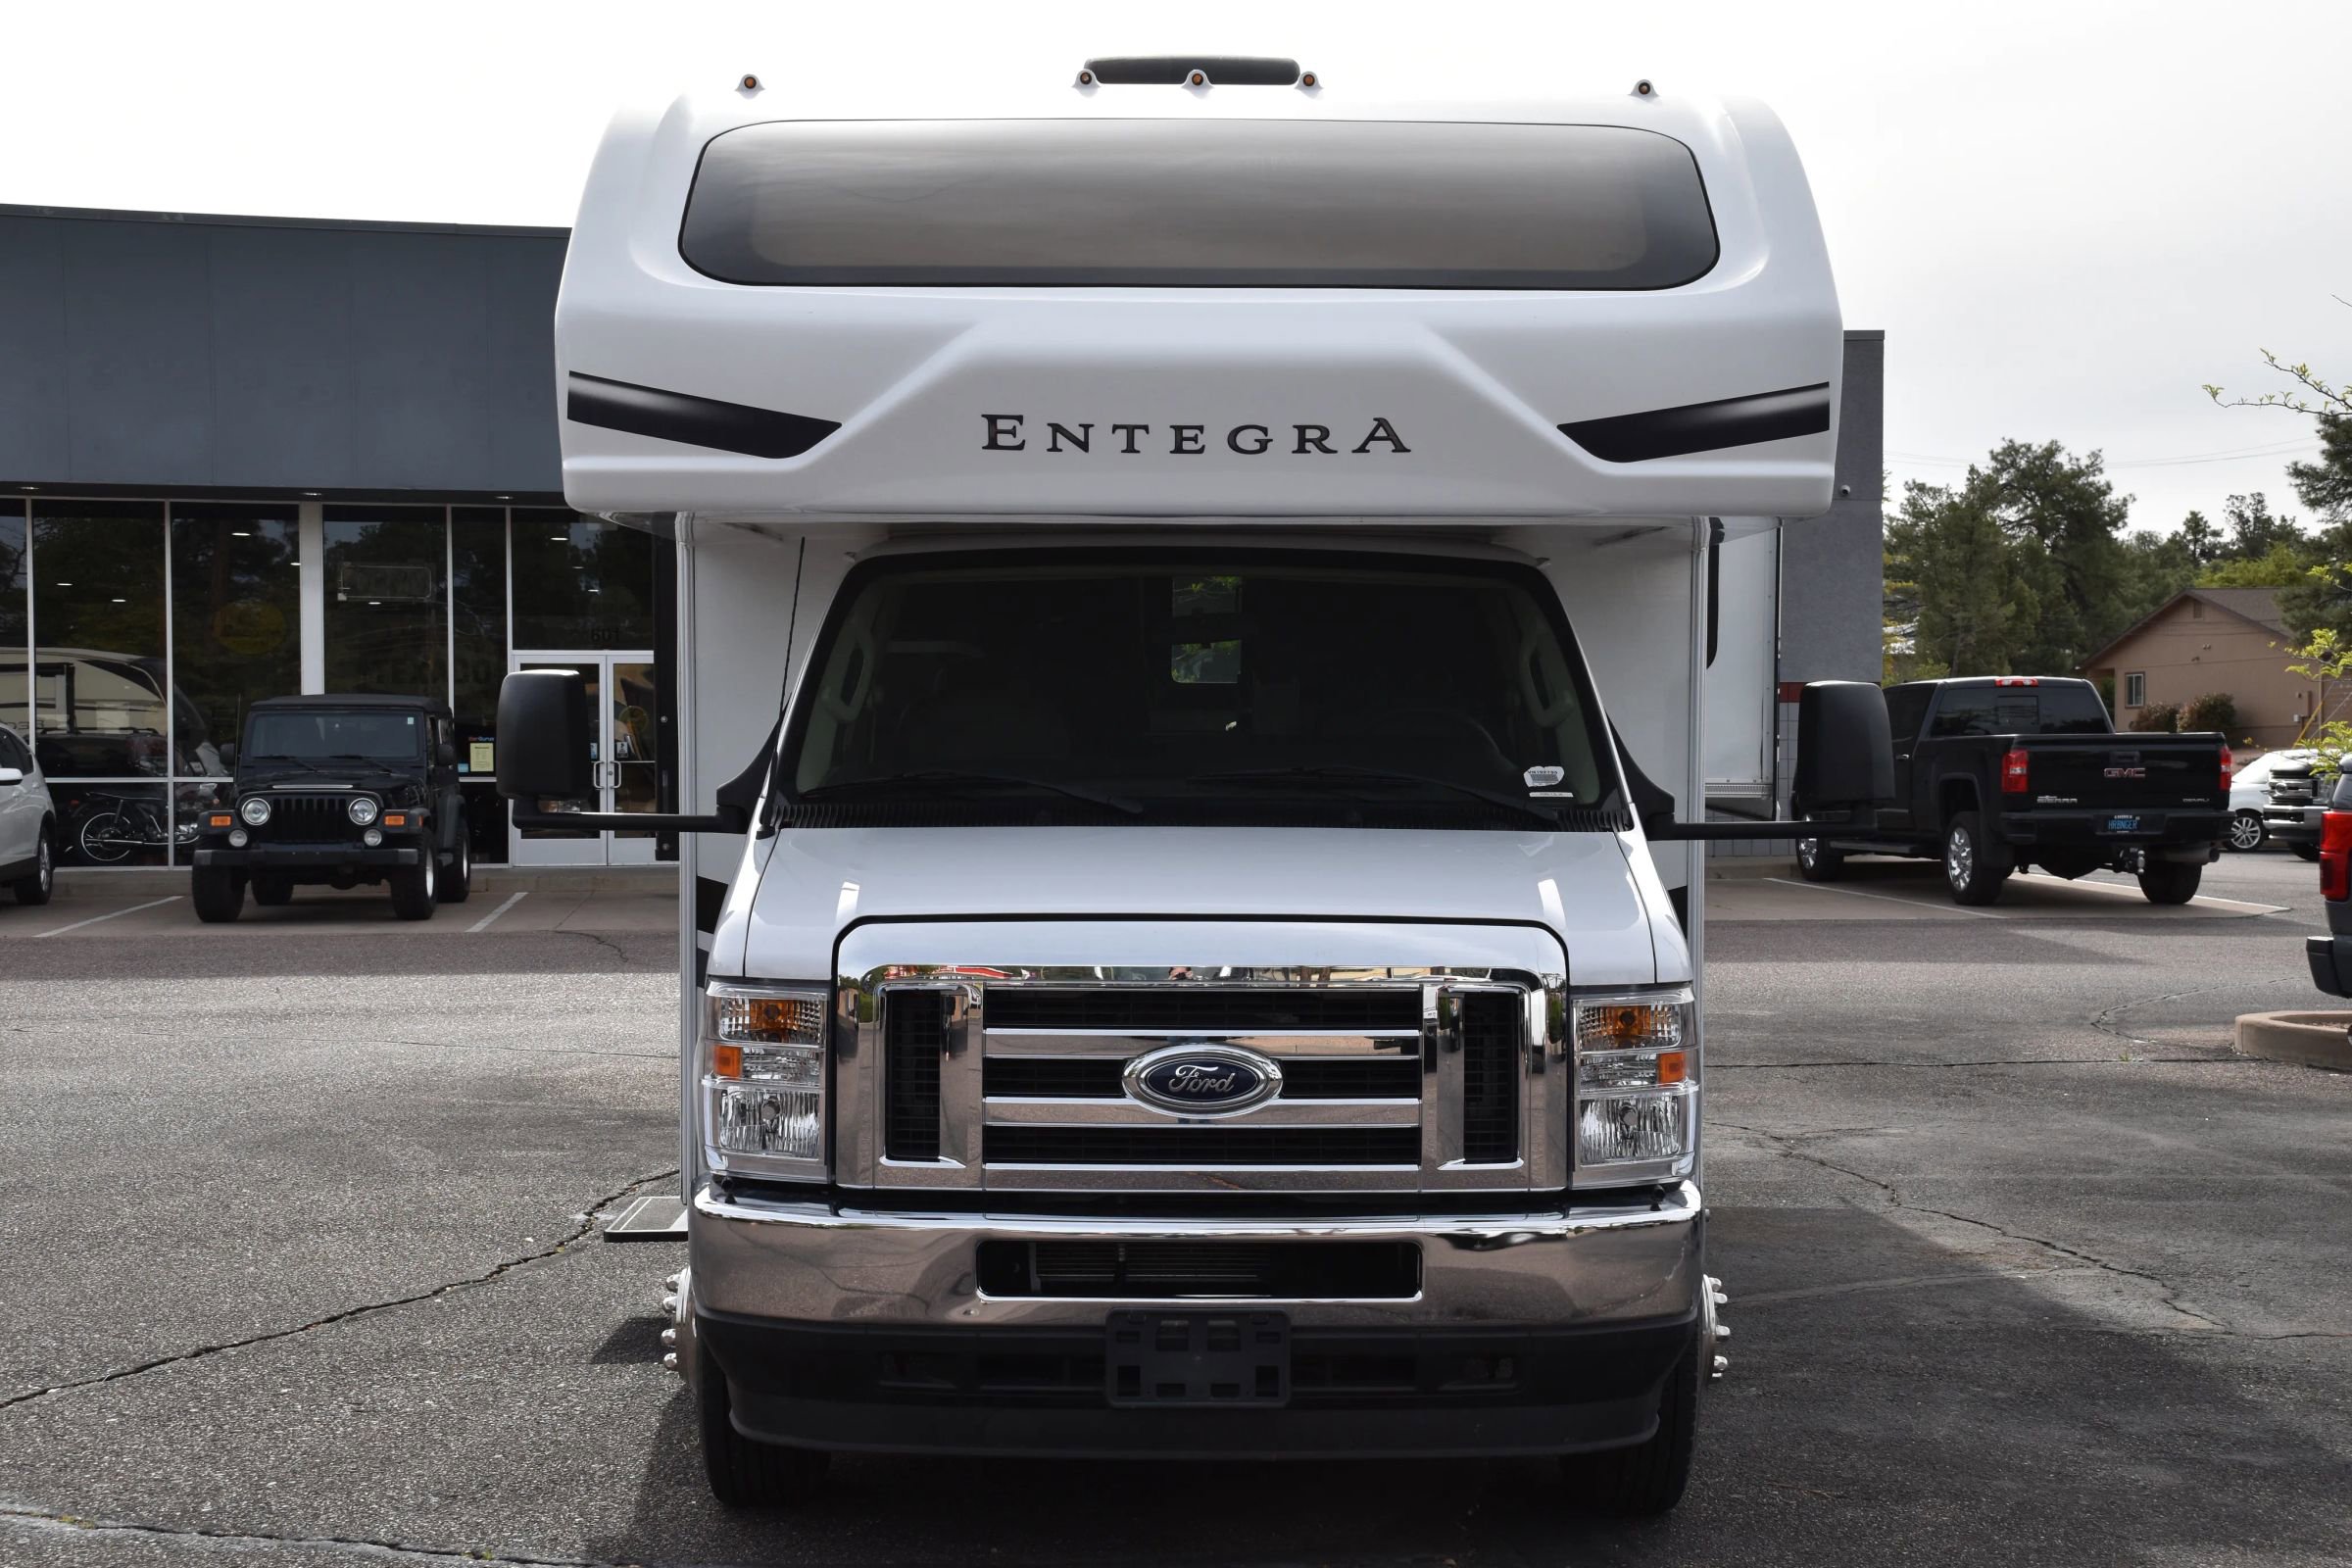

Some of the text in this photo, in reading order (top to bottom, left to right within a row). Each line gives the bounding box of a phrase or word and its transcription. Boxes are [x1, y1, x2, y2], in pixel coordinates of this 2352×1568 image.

[980, 413, 1411, 454] ENTEGRA
[2104, 768, 2145, 777] GMC
[1168, 1064, 1236, 1093] Ford
